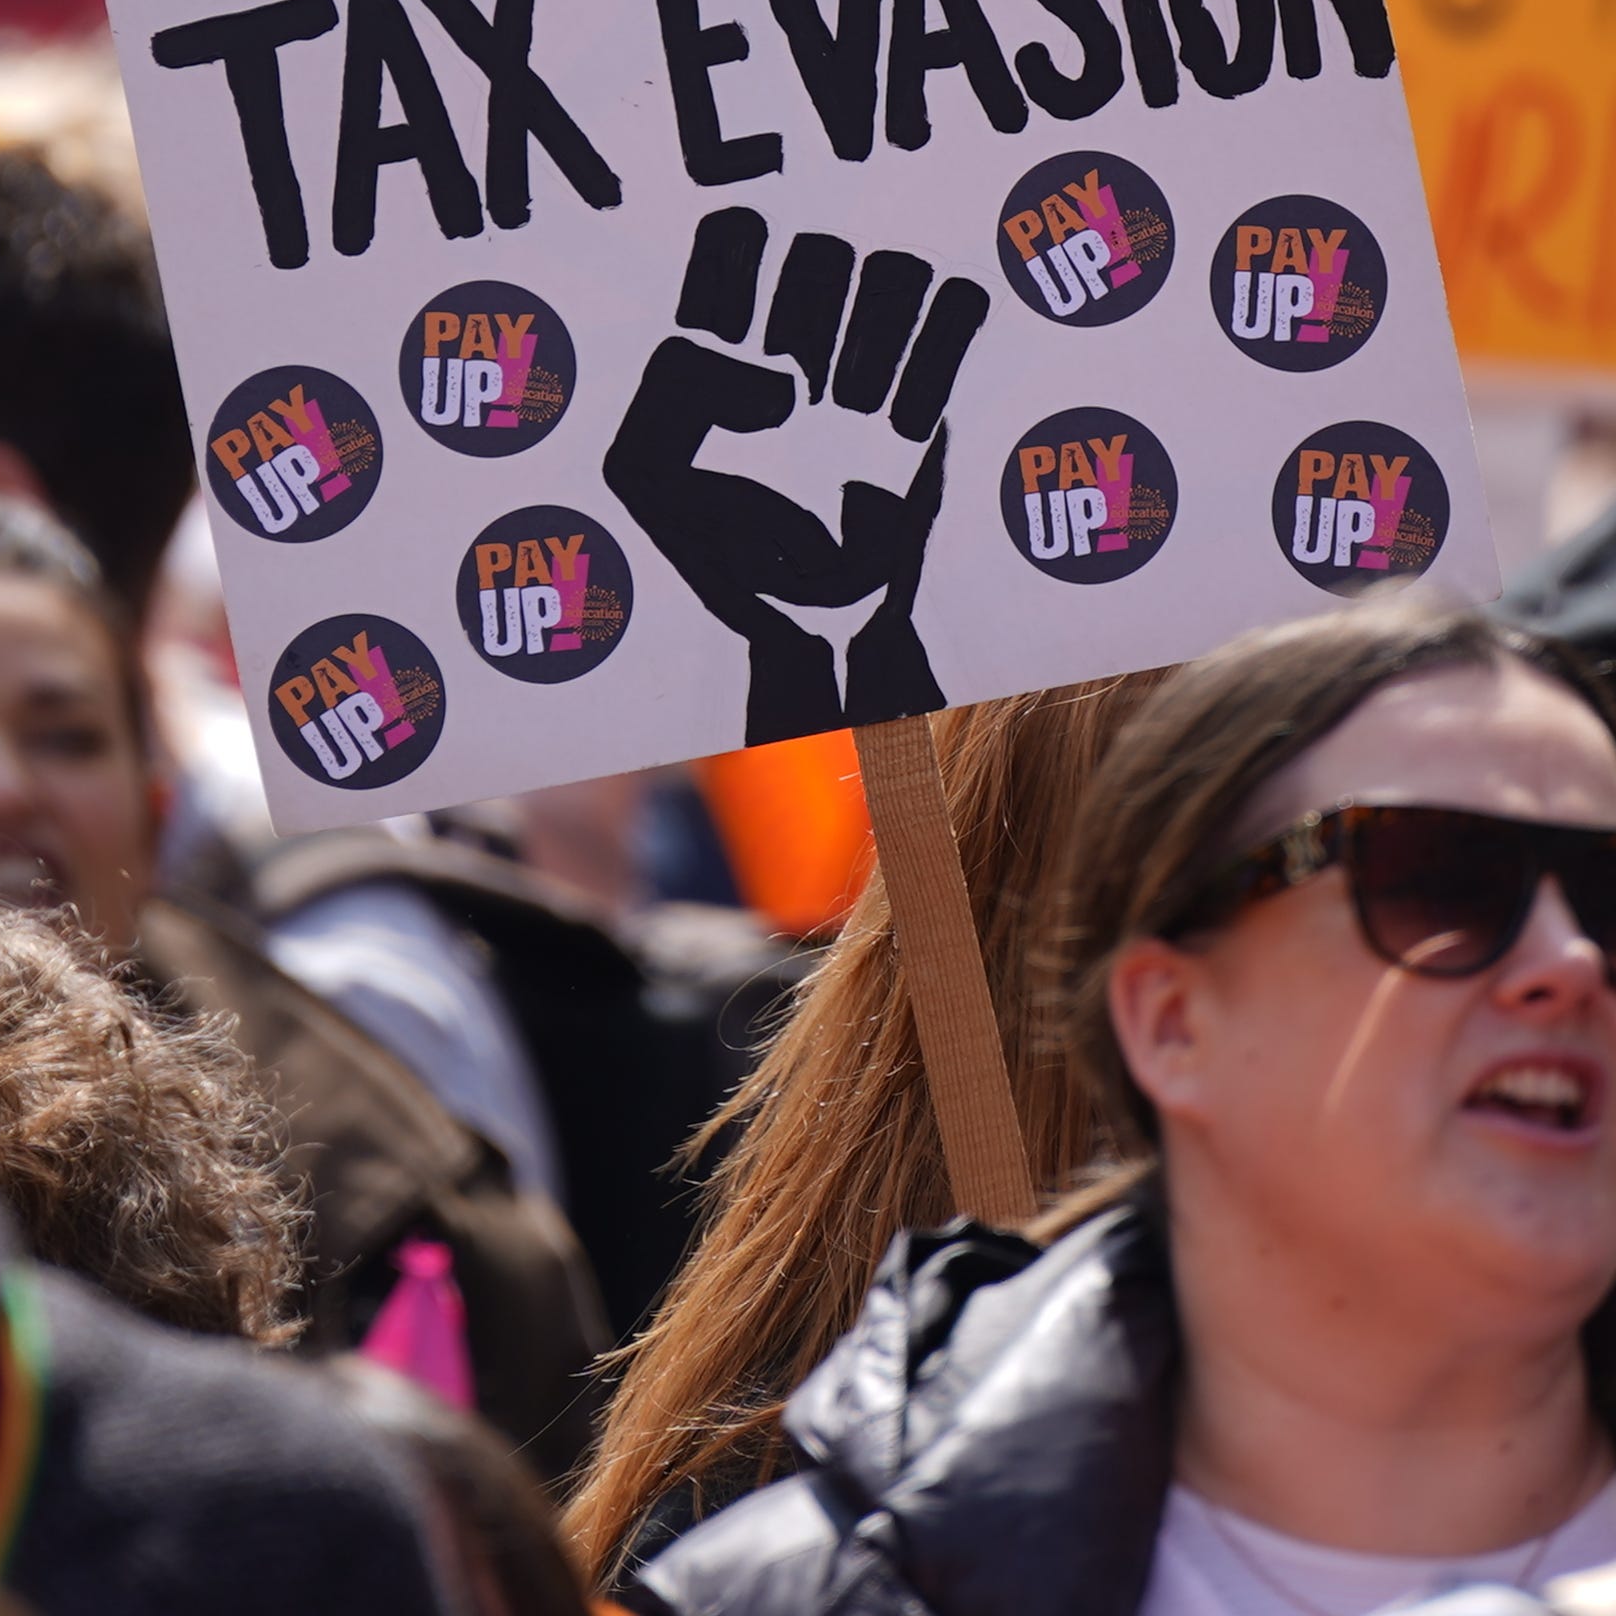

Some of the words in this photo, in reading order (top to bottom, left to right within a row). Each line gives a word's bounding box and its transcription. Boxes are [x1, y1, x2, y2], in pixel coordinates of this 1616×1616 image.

[1005, 171, 1109, 259] PAY
[1027, 186, 1141, 316] UP!
[1237, 226, 1345, 275] PAY
[425, 312, 533, 360] PAY
[1233, 248, 1349, 342] UP!
[422, 333, 537, 427] UP!
[212, 386, 315, 478] PAY
[237, 400, 351, 533] UP!
[1020, 435, 1126, 492] PAY
[1298, 451, 1408, 502] PAY
[1025, 454, 1133, 559] UP!
[1293, 475, 1411, 569] UP!
[476, 535, 583, 588] PAY
[480, 554, 589, 656] UP!
[276, 633, 379, 725] PAY
[301, 647, 415, 779] UP!
